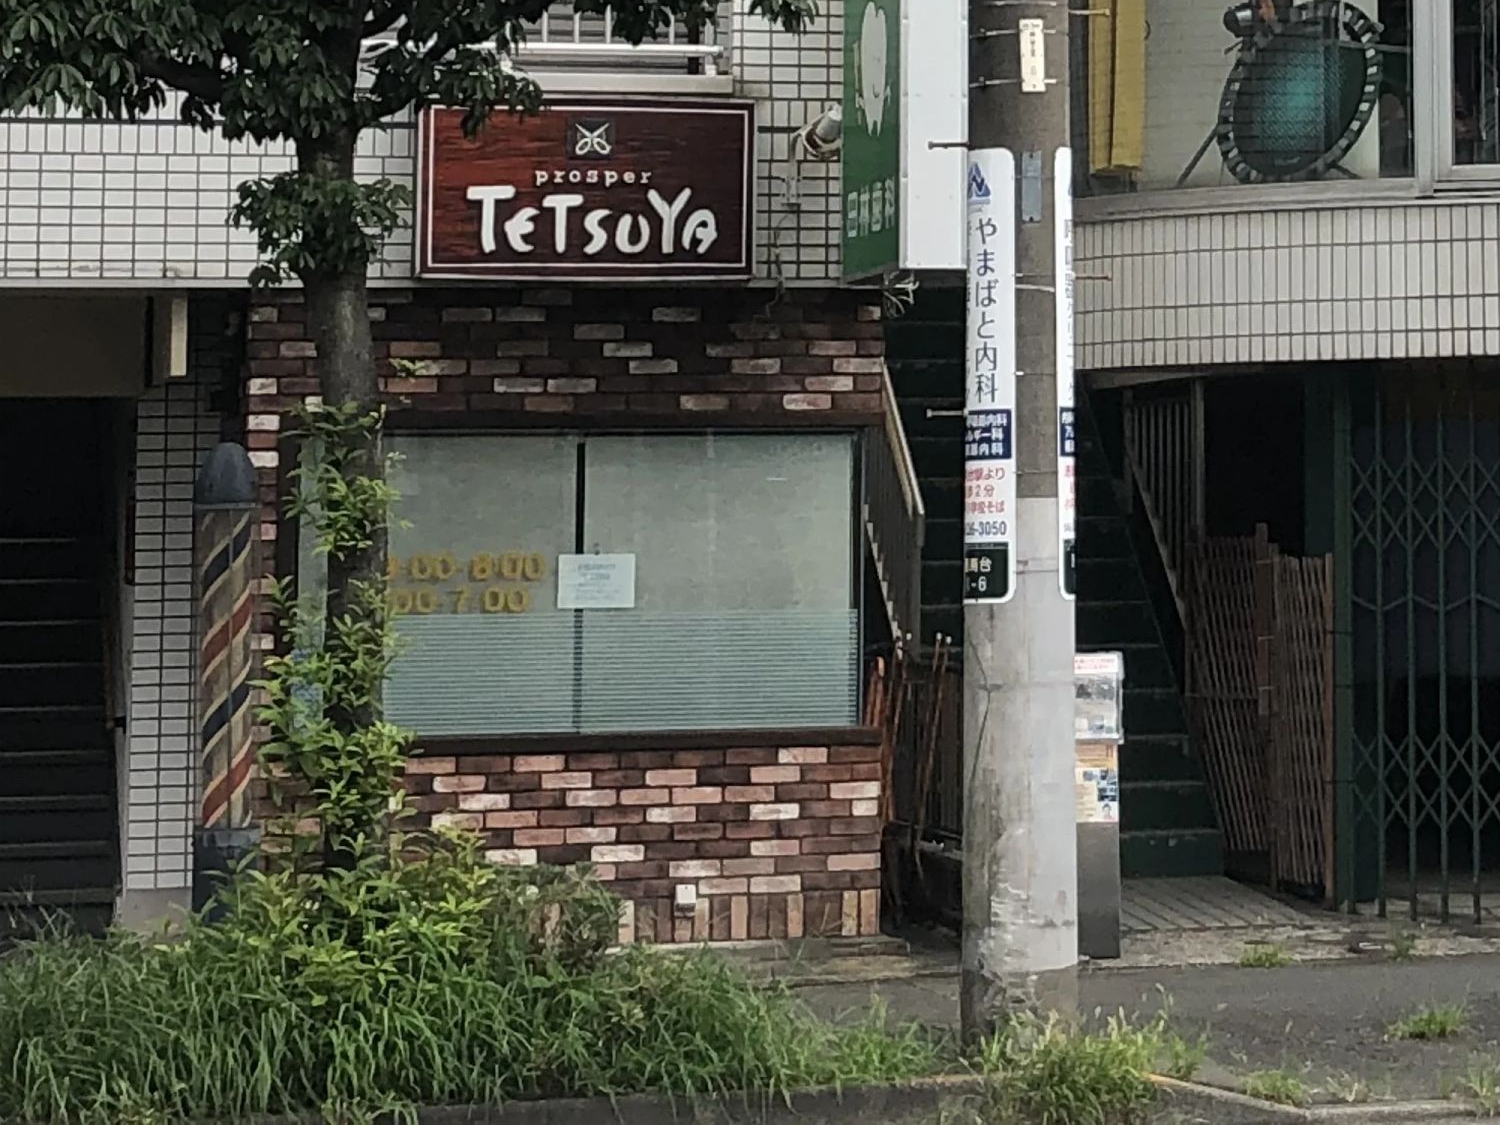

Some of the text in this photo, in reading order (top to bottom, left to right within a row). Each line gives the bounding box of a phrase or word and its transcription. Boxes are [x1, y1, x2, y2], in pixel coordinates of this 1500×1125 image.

[534, 168, 653, 188] prosper
[974, 216, 1000, 404] やまばと内科
